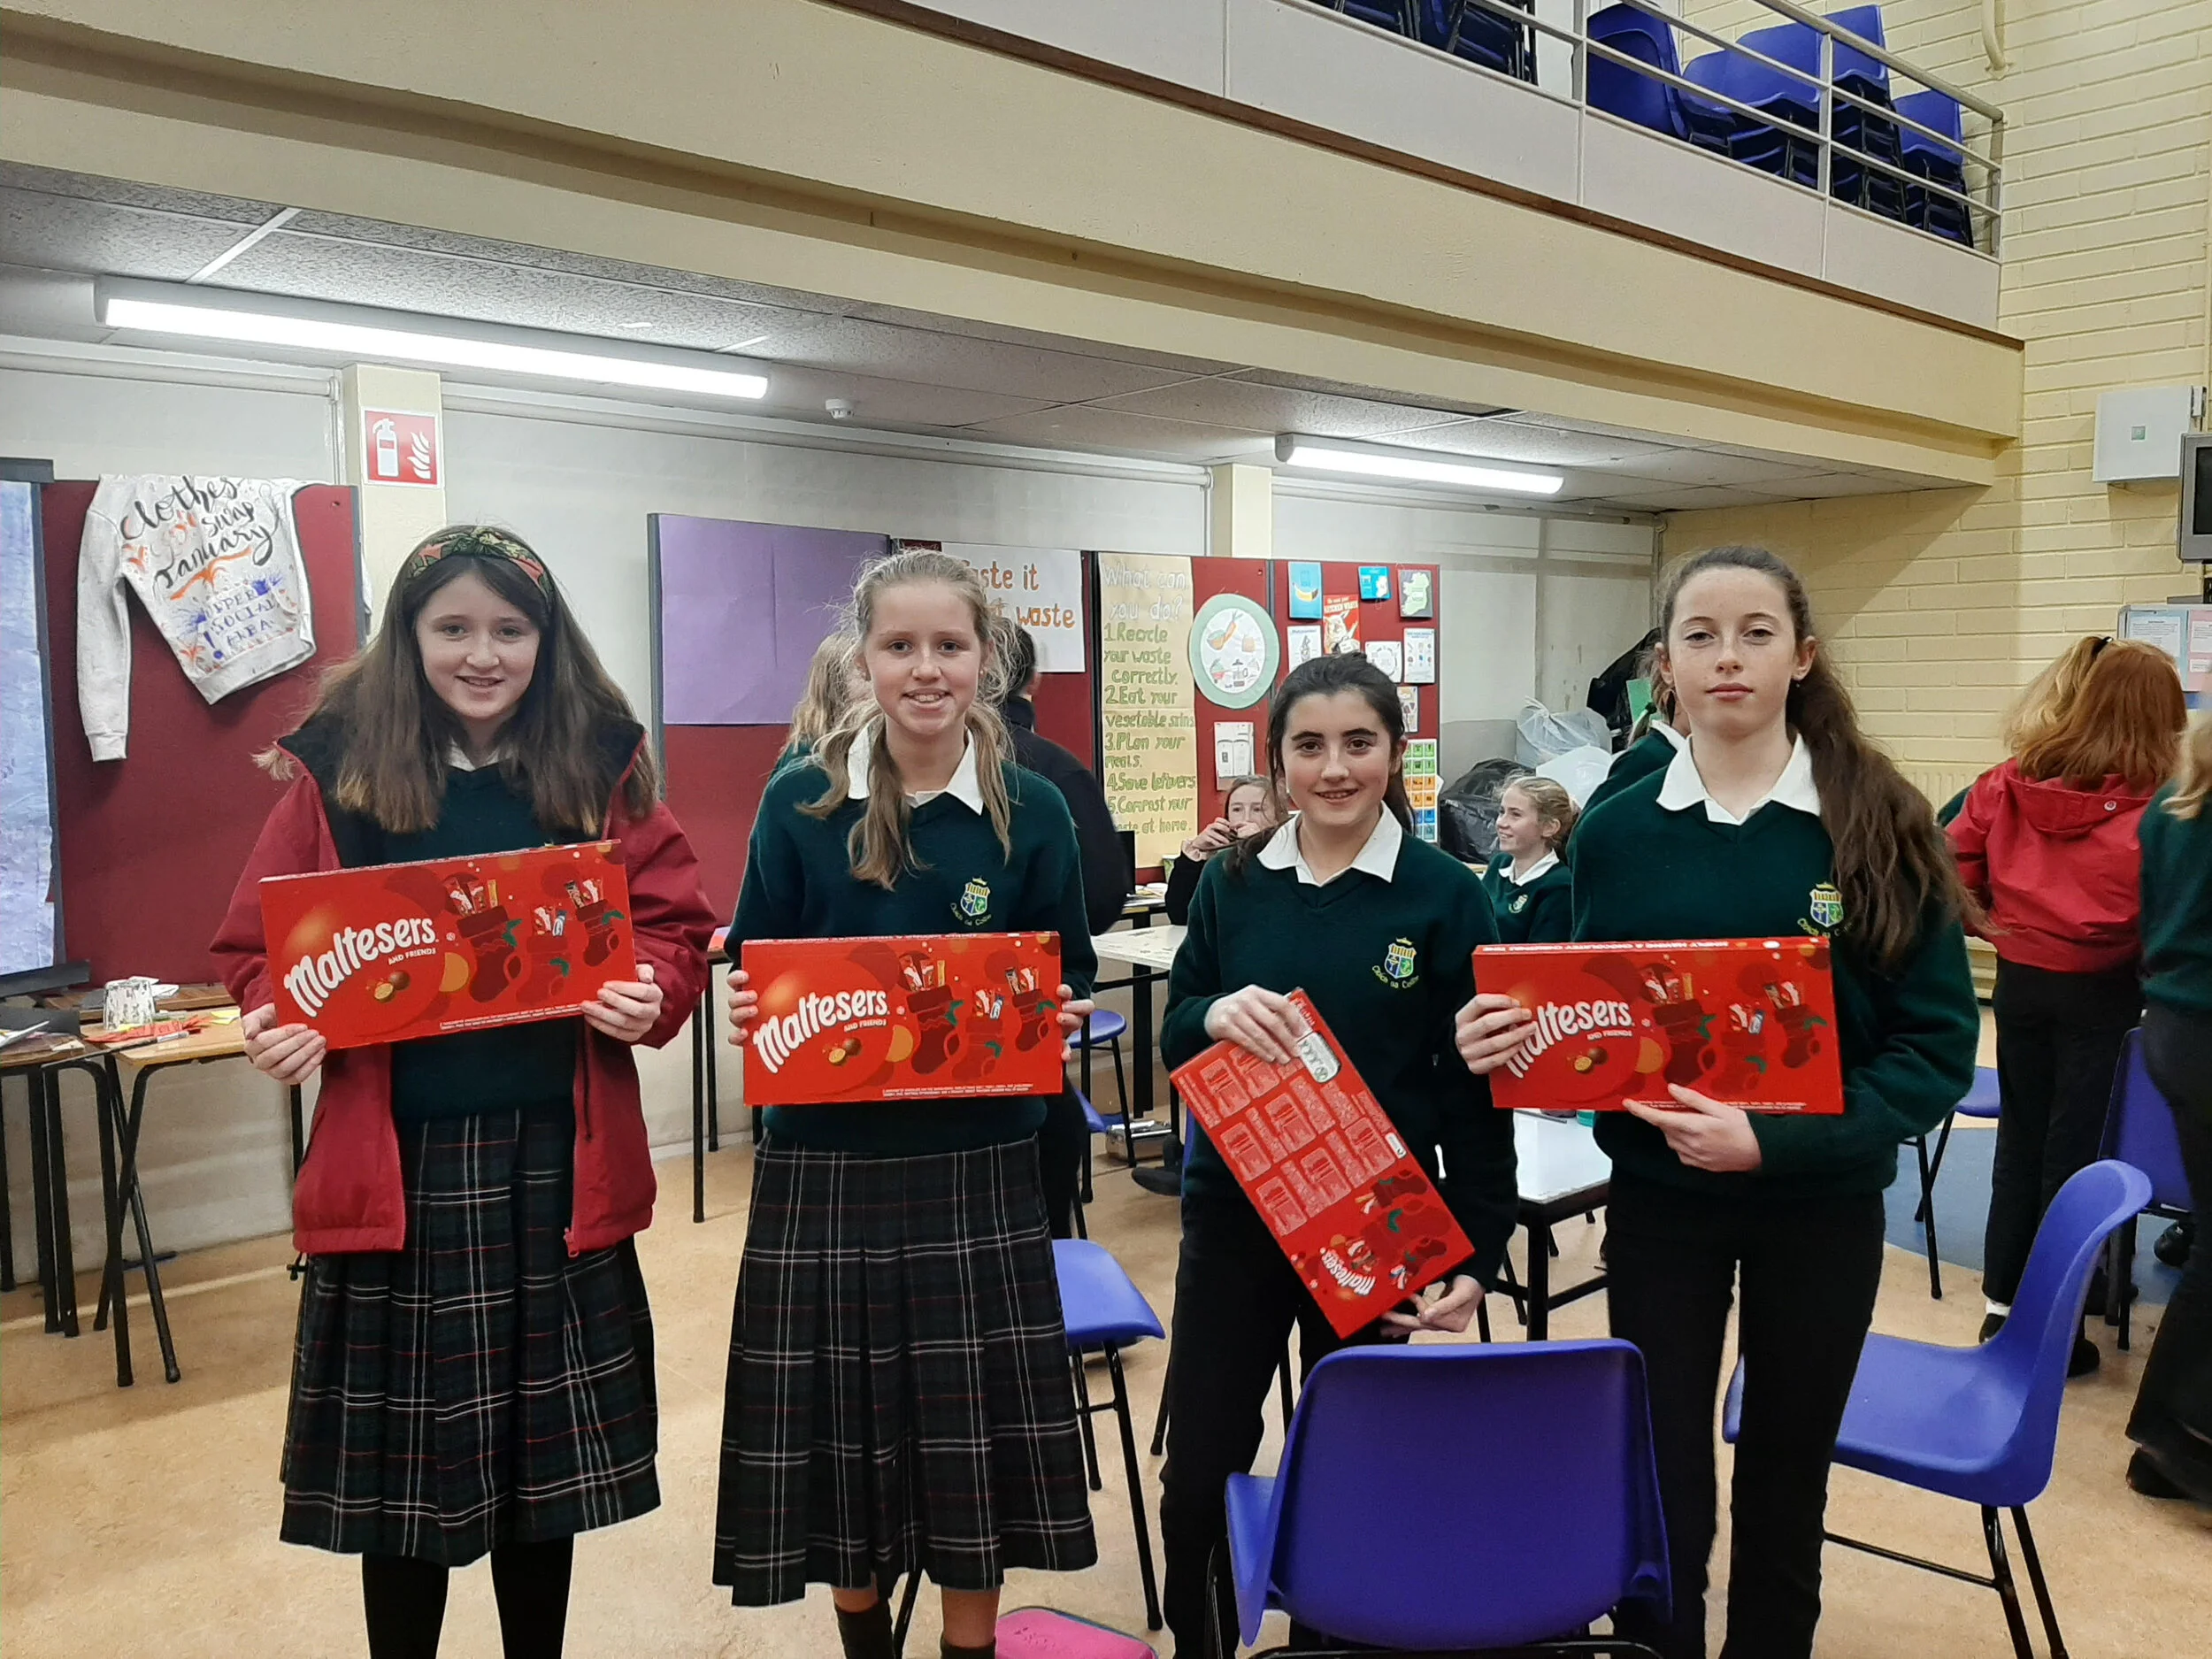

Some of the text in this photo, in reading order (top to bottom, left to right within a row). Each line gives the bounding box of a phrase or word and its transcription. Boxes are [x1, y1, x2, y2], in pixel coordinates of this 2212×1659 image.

[1023, 564, 1040, 591] it
[1017, 603, 1075, 628] waste
[1110, 595, 1184, 621] you do?
[1133, 647, 1171, 664] waste
[1106, 710, 1166, 728] vegetable
[1155, 736, 1186, 750] your
[388, 948, 436, 965] AND FRIENDS
[283, 918, 435, 1017] Maltesers
[753, 989, 887, 1074] Maltesers
[843, 1018, 887, 1033] AND FRIENDS
